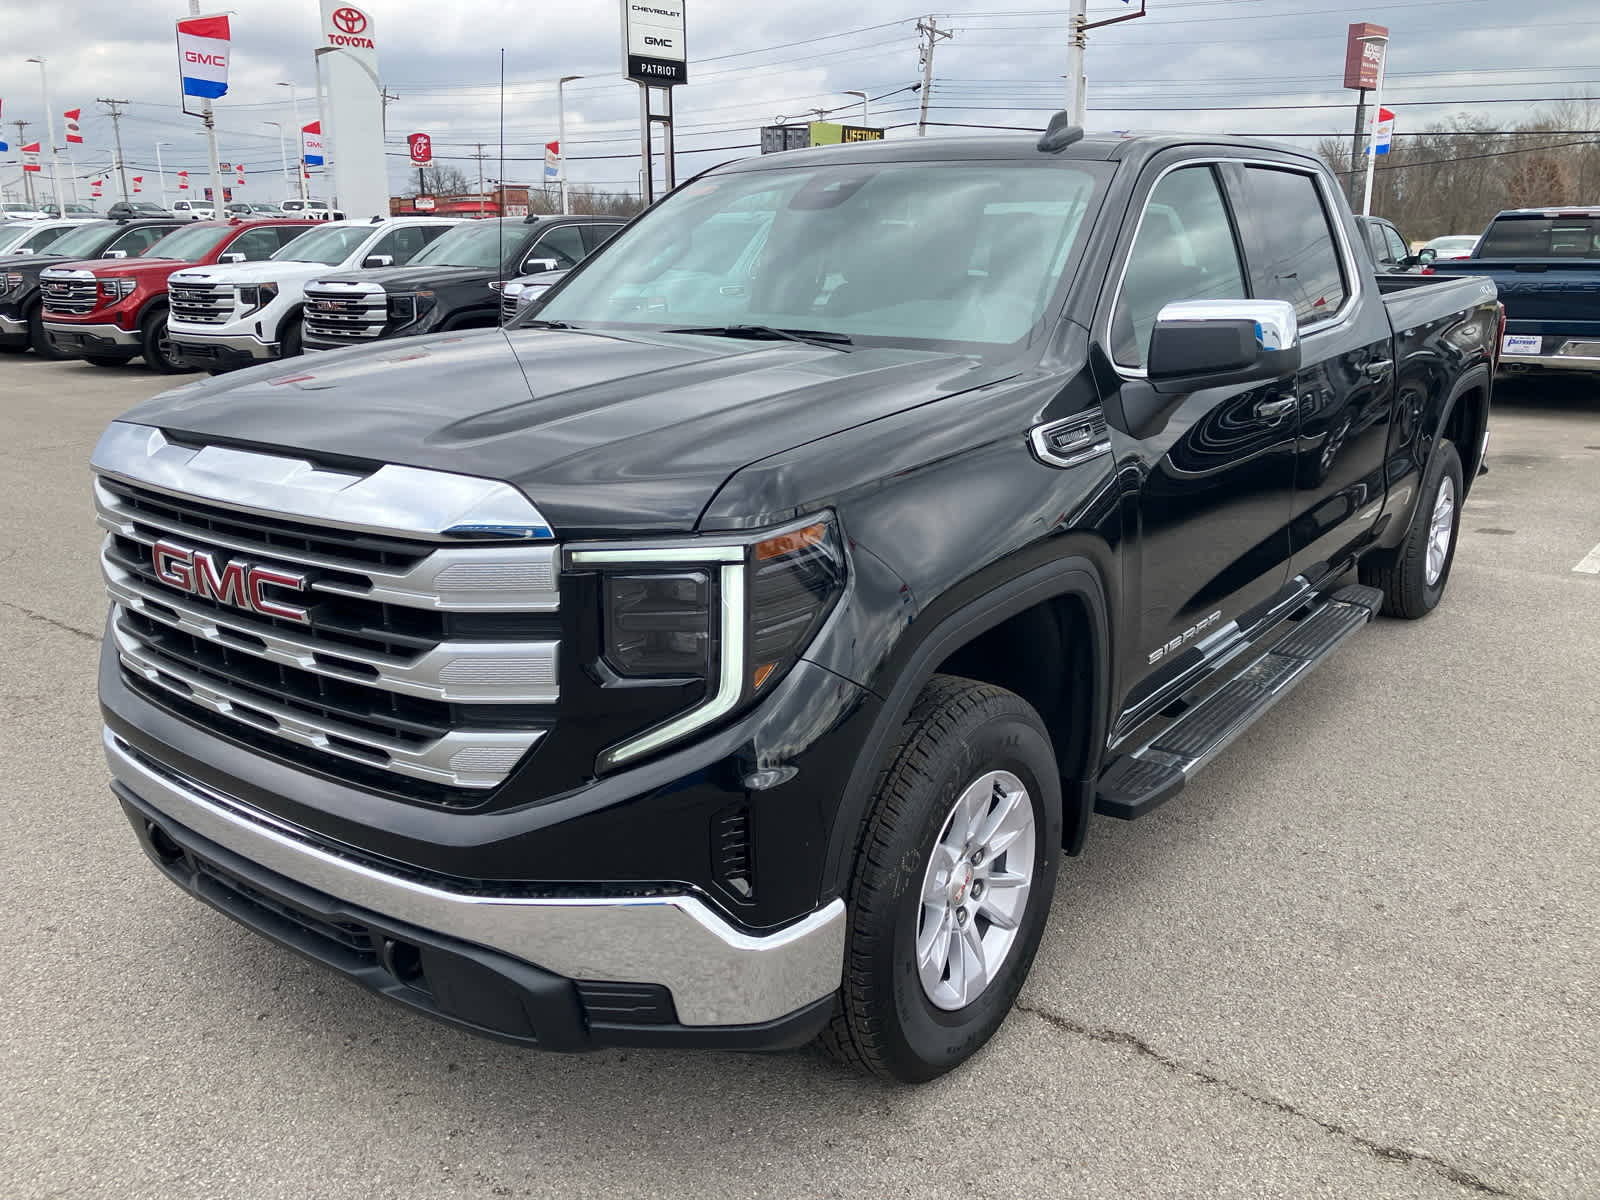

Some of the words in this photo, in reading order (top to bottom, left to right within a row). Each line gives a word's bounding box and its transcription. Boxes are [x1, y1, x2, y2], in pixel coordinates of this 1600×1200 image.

[632, 5, 680, 17] CHEVROLET
[328, 34, 374, 49] TOYOTA
[644, 36, 673, 48] GMC
[185, 51, 225, 67] GMC
[641, 63, 677, 77] PATRIOT
[317, 300, 348, 311] GMC
[152, 539, 312, 625] GMC
[1148, 609, 1222, 665] SIERRA
